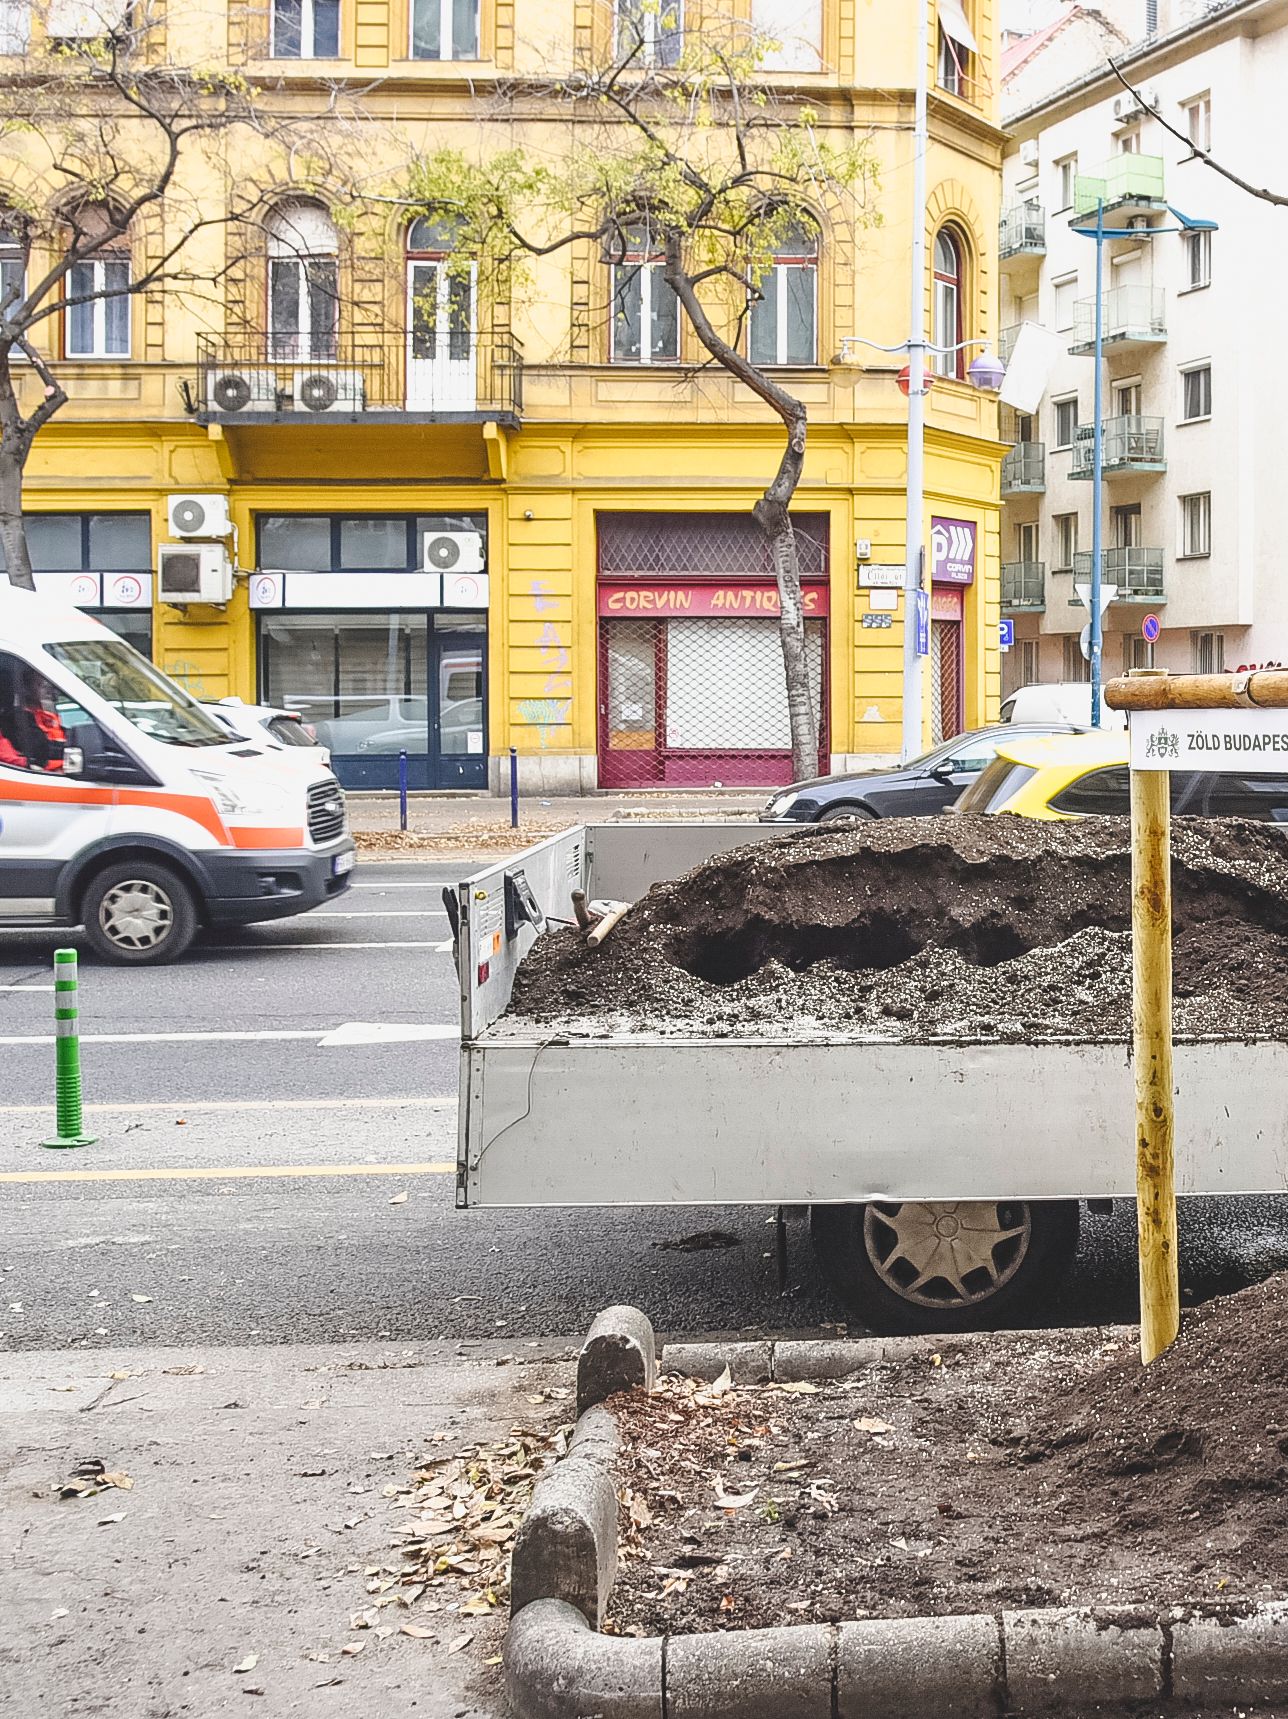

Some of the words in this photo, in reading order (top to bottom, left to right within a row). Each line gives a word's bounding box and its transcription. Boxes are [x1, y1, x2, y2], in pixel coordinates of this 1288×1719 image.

[607, 590, 692, 610] CORVIN
[710, 590, 818, 612] ANTIQS
[1186, 730, 1221, 751] ZÖLD
